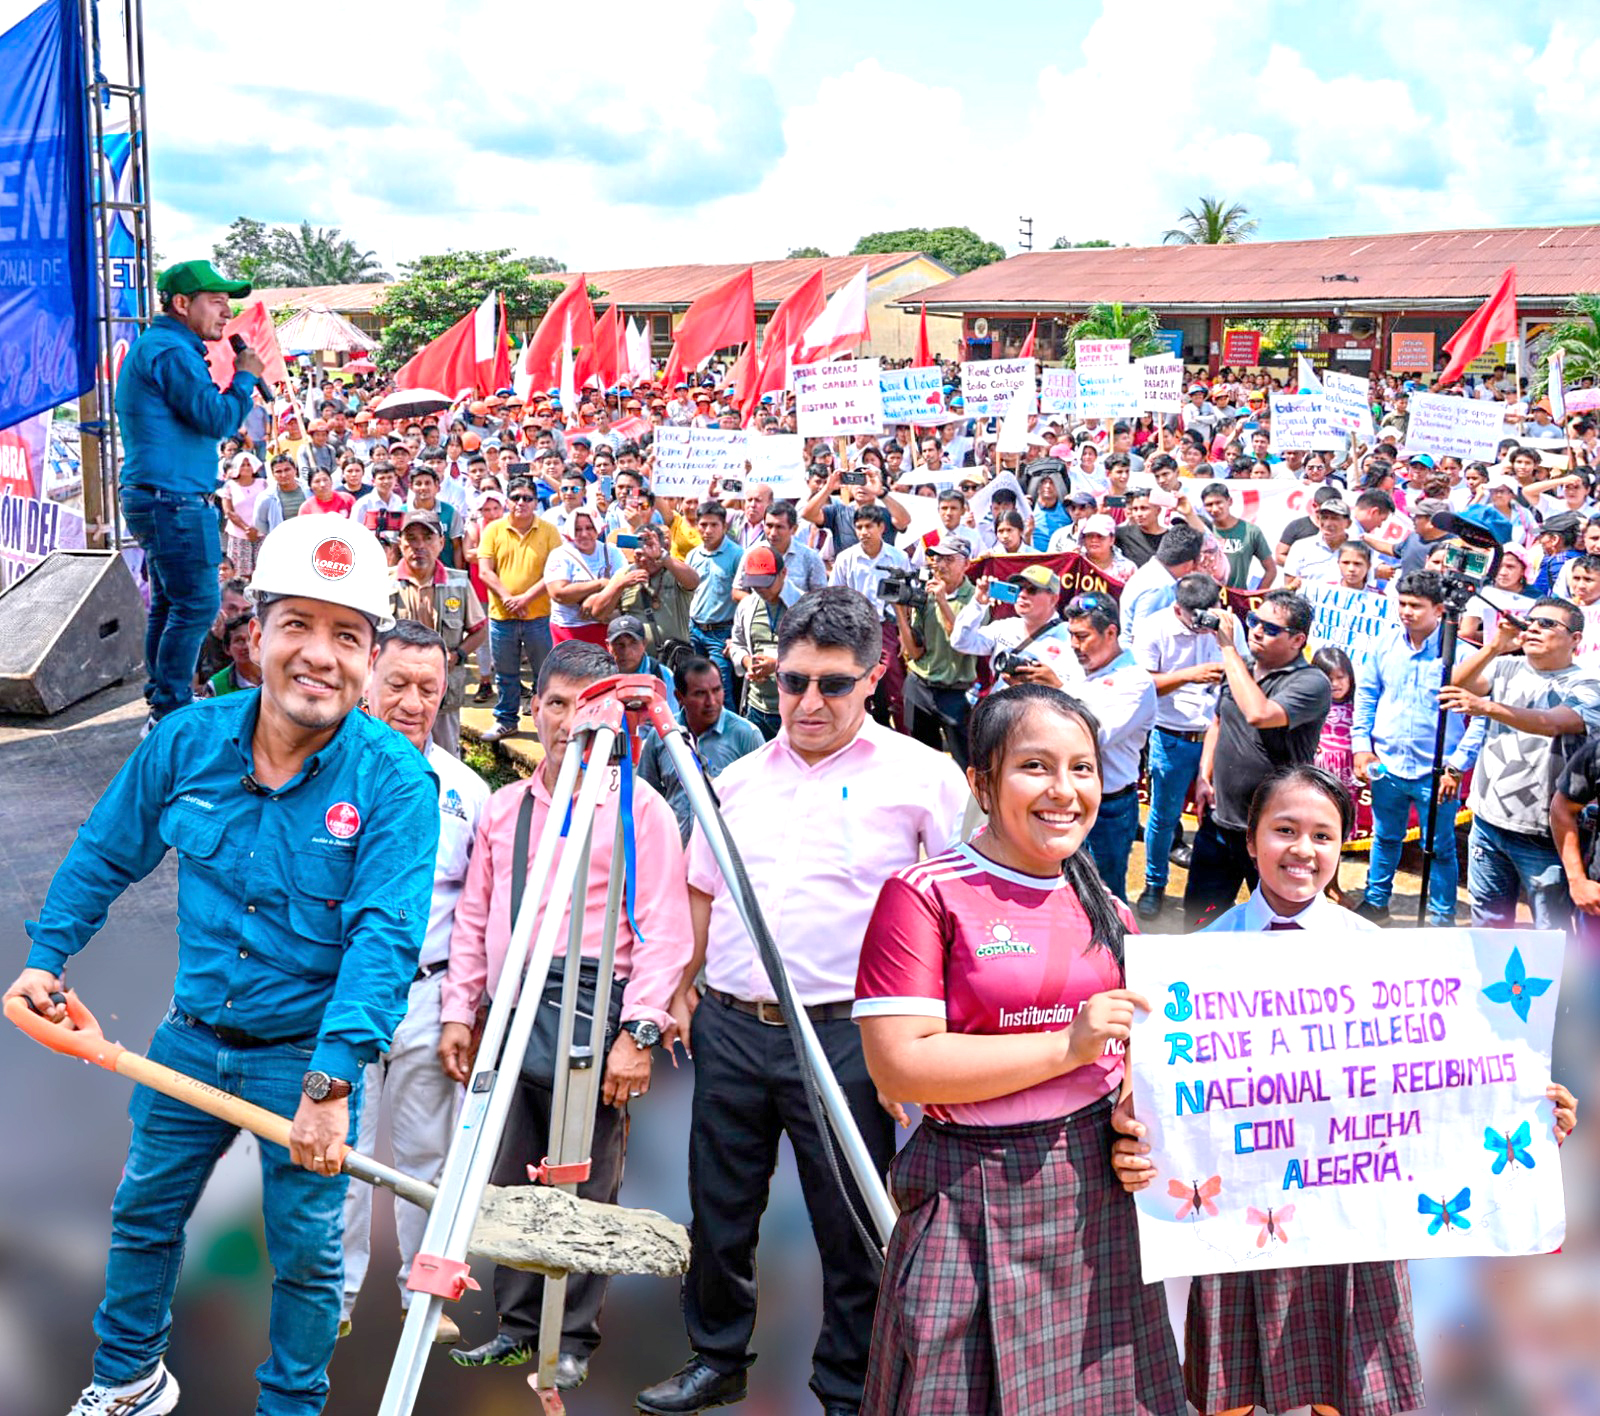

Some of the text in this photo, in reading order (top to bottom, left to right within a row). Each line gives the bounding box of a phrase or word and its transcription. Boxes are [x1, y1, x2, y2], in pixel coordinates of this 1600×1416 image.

[41, 258, 62, 286] DE
[822, 364, 858, 375] GRACIAS
[822, 380, 858, 389] CAMBIAR
[863, 379, 874, 387] LA
[0, 445, 28, 481] BRA
[27, 501, 59, 556] DEL
[999, 1004, 1074, 1028] Institución
[1164, 977, 1462, 1022] BIENVENIDOS DOCTOR
[1164, 1012, 1447, 1065] RENE A TU COLEGIO
[1175, 1053, 1517, 1116] NACIONAL TE RECIBIMOS
[1234, 1109, 1422, 1155] CON MUCHA
[1282, 1140, 1414, 1190] ALEGRÍA.
